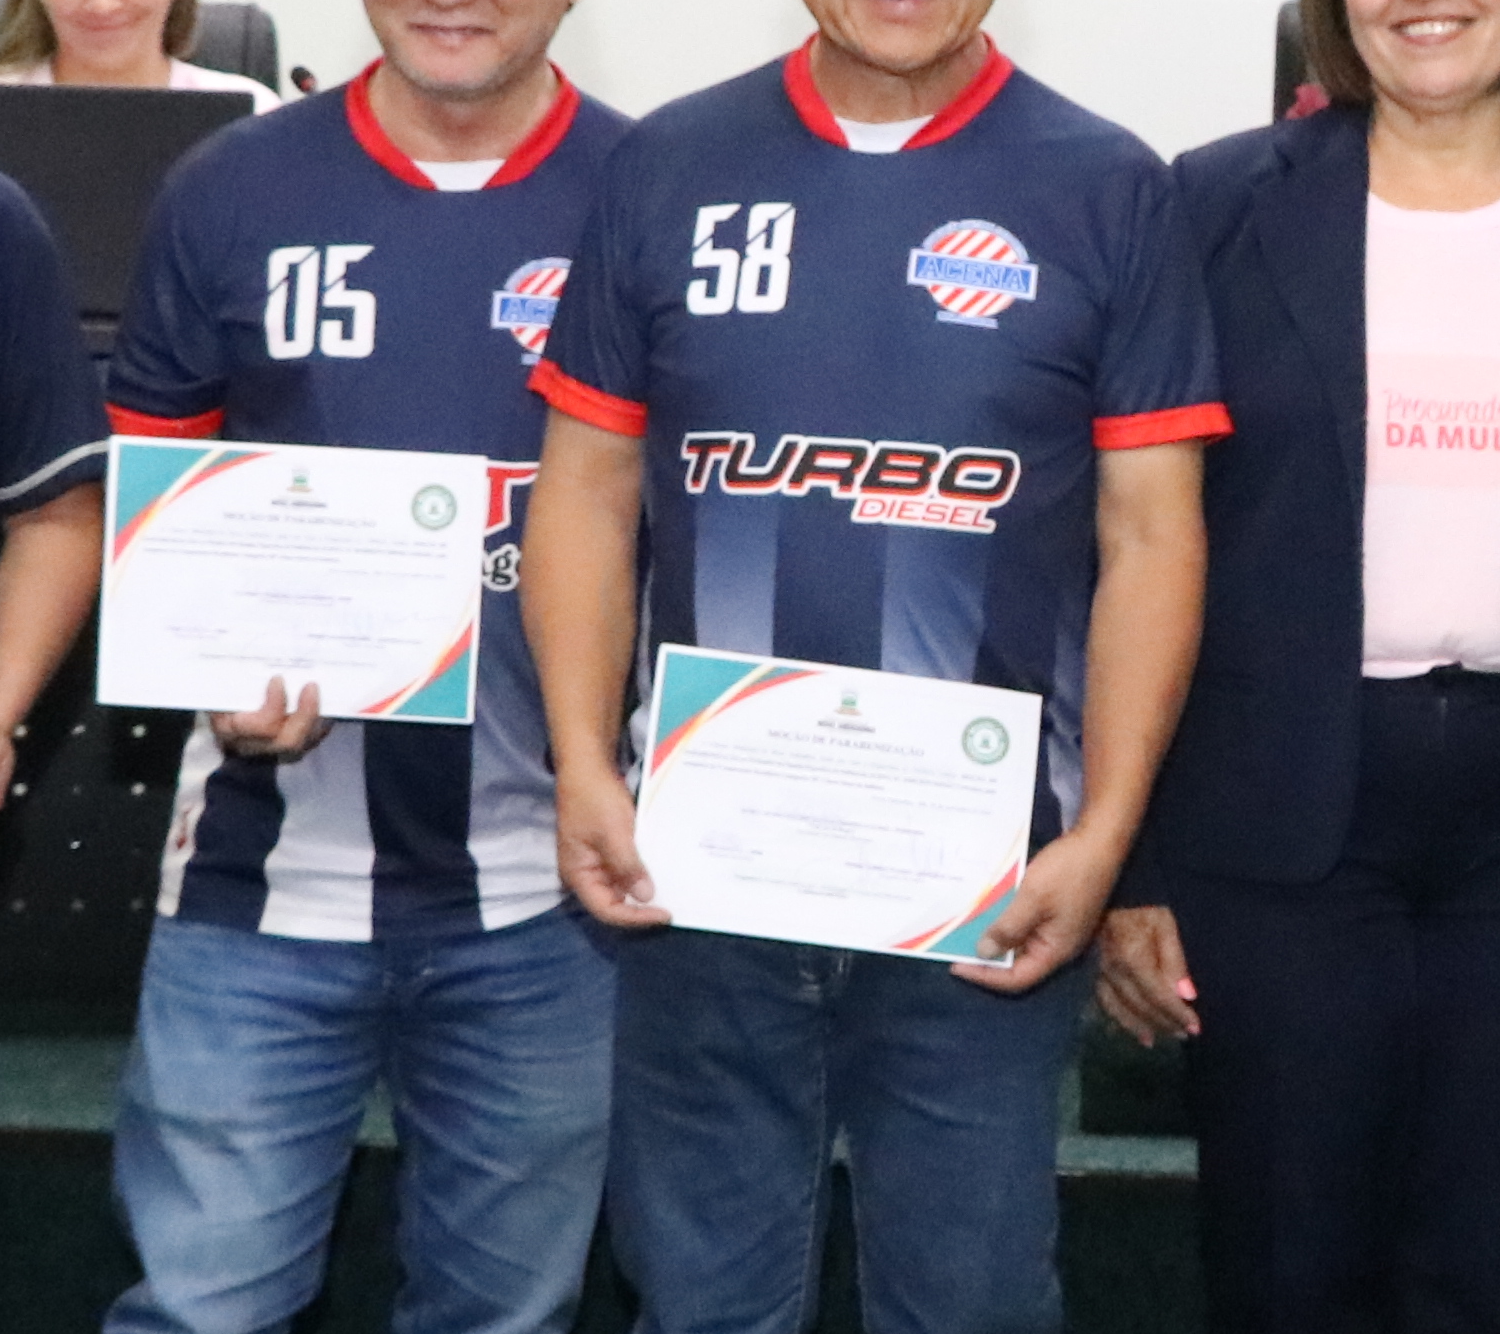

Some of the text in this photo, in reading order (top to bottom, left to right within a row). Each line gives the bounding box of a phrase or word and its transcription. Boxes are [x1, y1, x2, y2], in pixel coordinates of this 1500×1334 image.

[687, 202, 796, 315] 58
[916, 256, 1029, 293] ACENA
[266, 245, 376, 360] 05
[1385, 422, 1427, 448] DA
[681, 432, 1021, 507] TURBO
[855, 498, 996, 529] DIESEL
